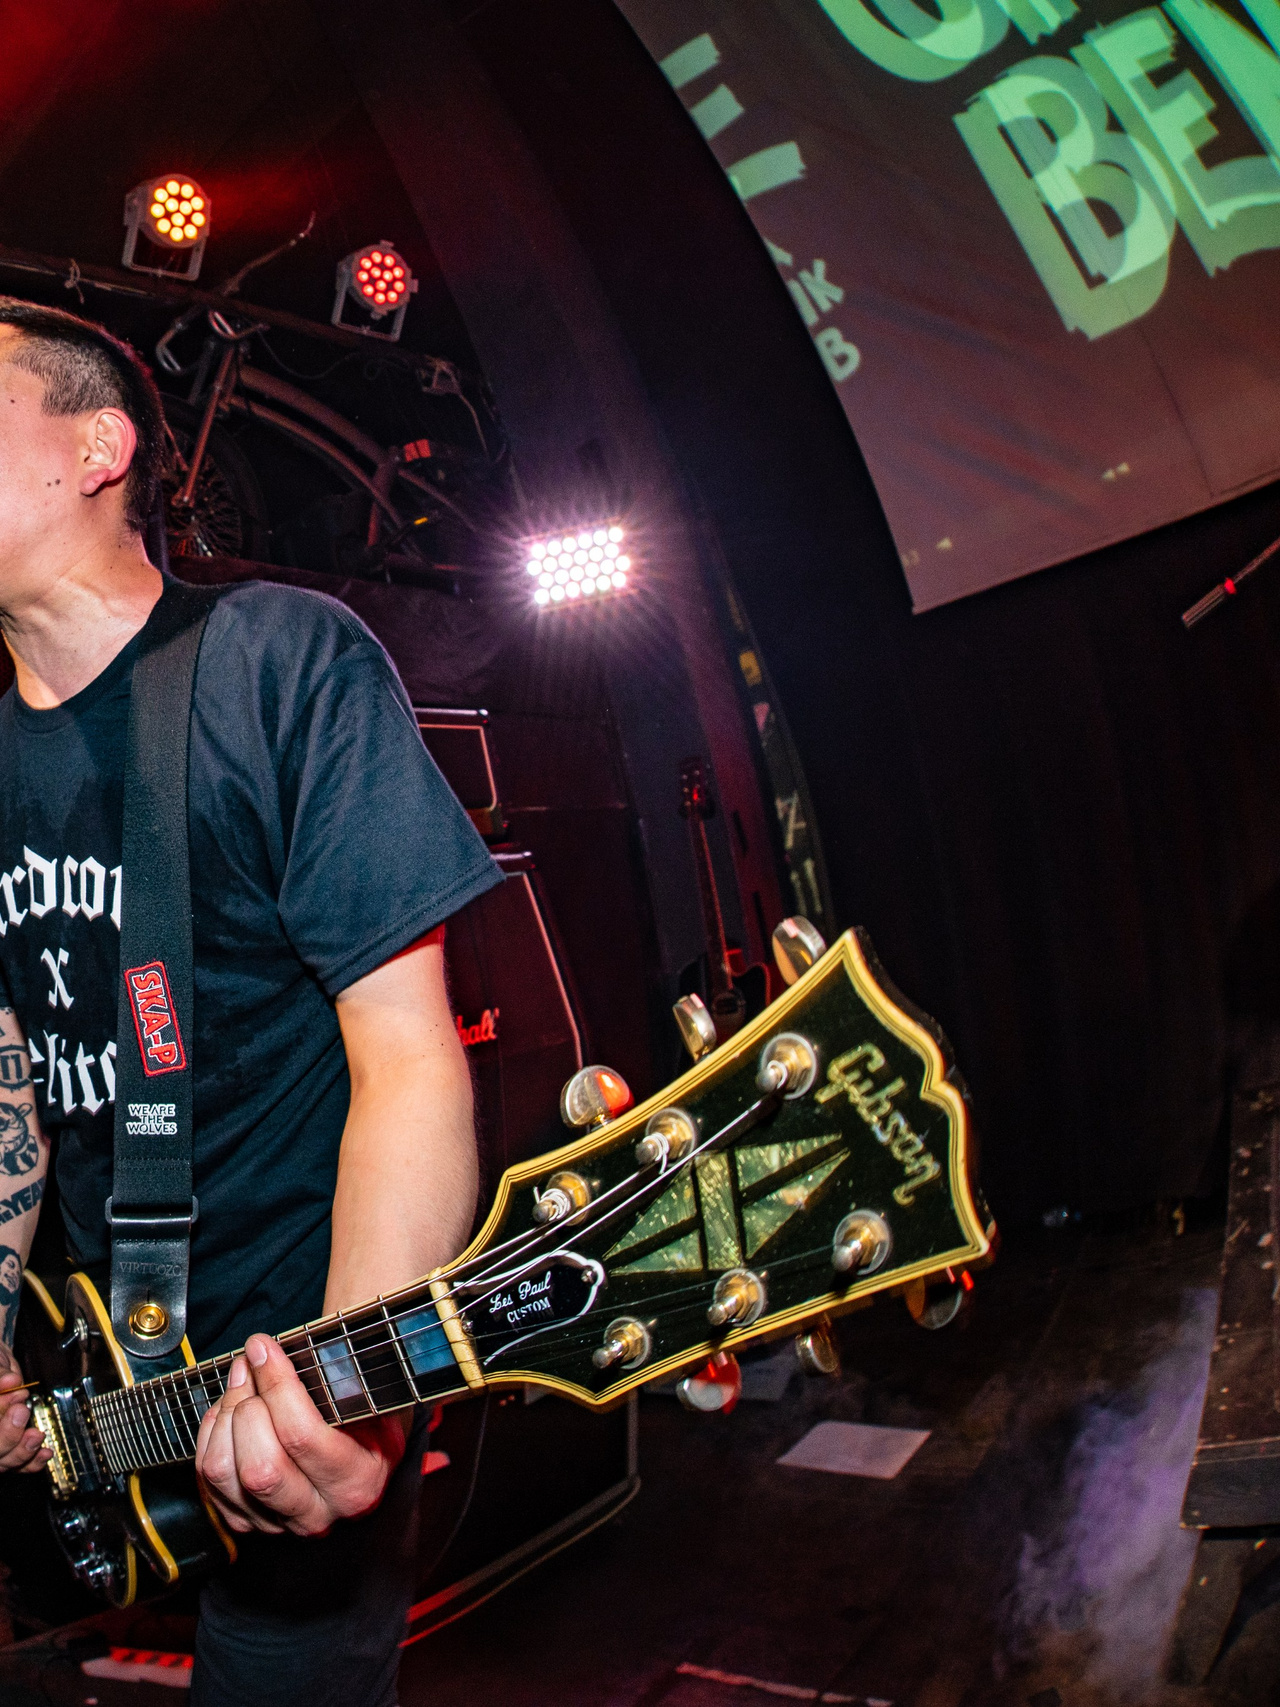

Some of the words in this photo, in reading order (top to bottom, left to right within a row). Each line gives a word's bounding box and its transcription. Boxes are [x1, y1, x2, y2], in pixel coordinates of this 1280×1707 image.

[132, 971, 178, 1064] SKA-P
[456, 1007, 499, 1047] hall
[126, 1121, 178, 1135] WOLVES
[140, 1114, 164, 1124] THE
[815, 1042, 941, 1206] Gibson
[119, 1261, 182, 1277] VIRTUOZO
[489, 1293, 513, 1313] Les
[518, 1271, 551, 1300] Paul
[507, 1297, 551, 1323] CUSTOM
